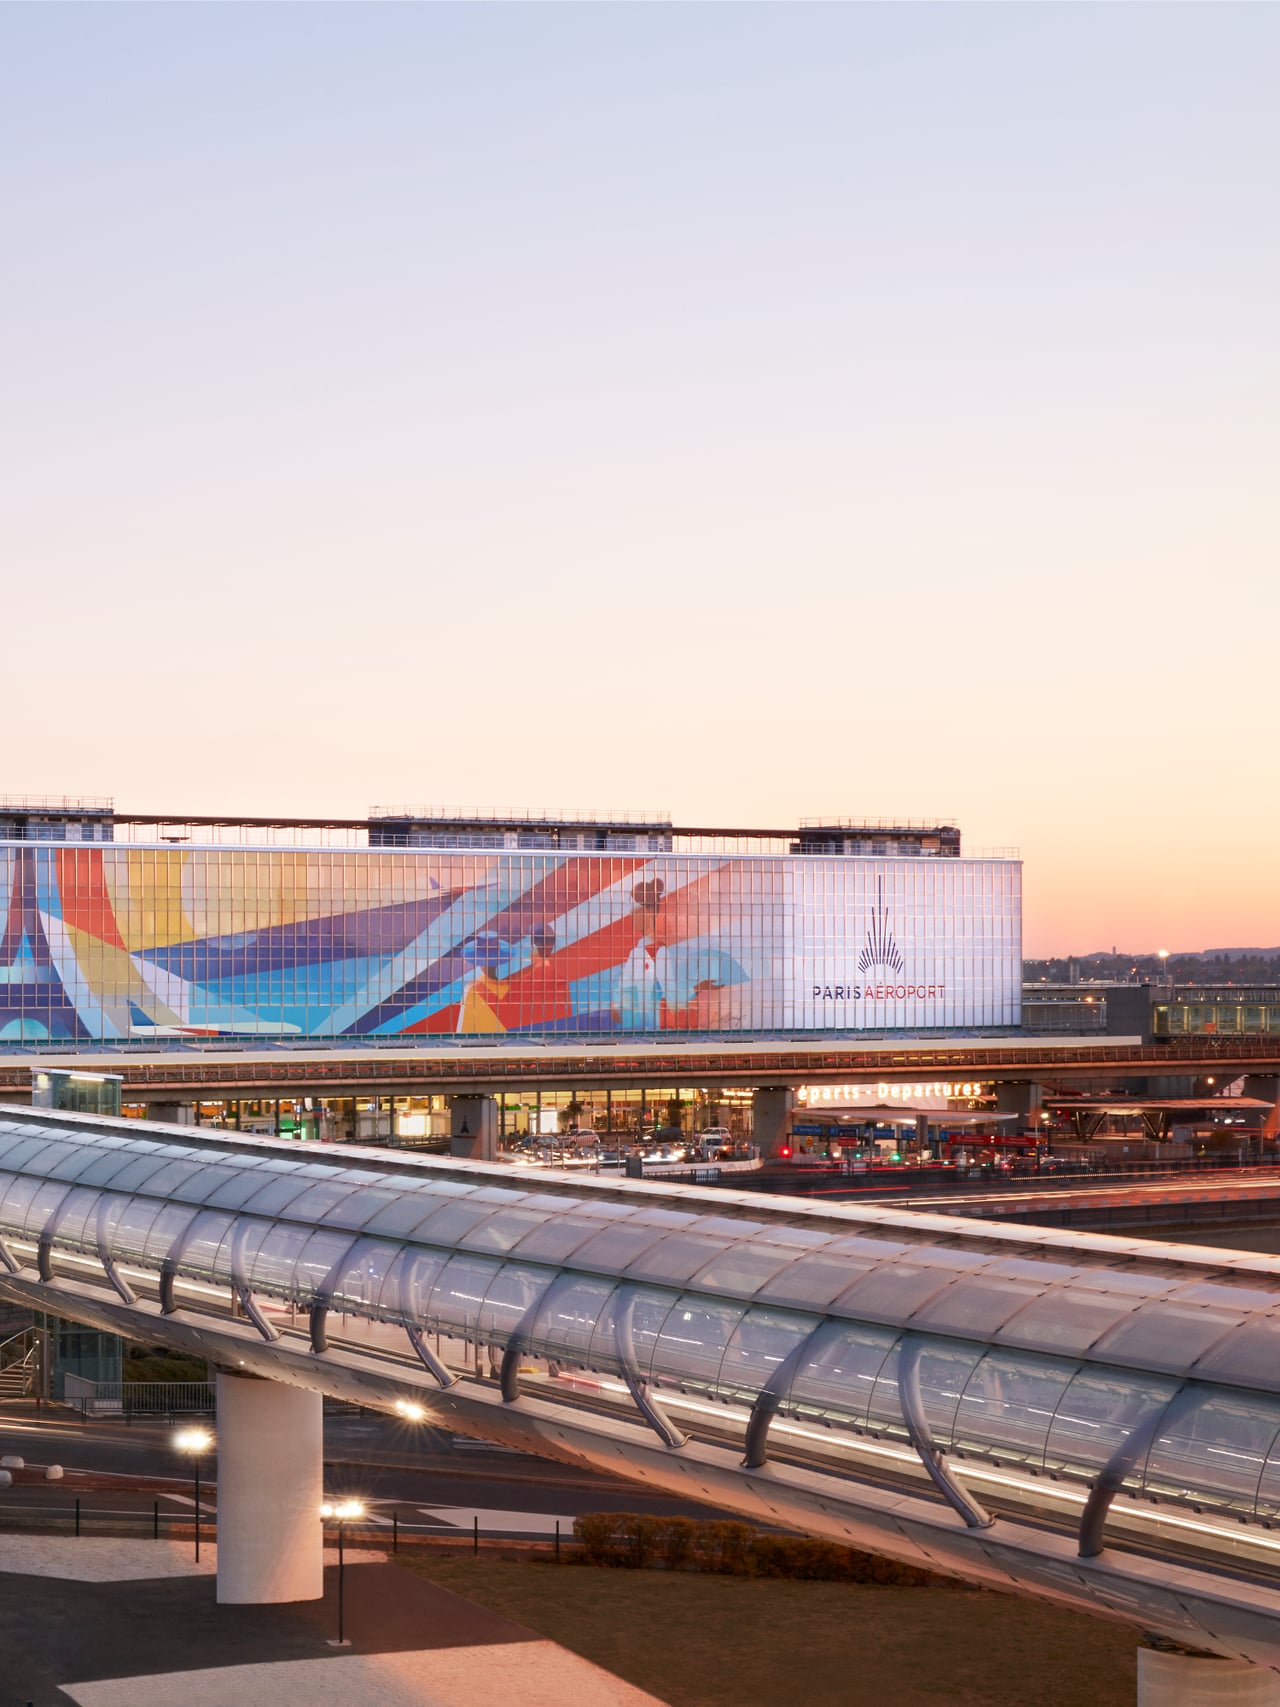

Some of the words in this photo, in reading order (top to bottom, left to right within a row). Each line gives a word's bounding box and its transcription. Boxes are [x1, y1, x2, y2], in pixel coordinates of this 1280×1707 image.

[813, 986, 860, 1000] PARIS
[865, 982, 945, 999] AÉROPORT
[798, 1085, 859, 1103] éparts
[877, 1083, 981, 1100] Departures
